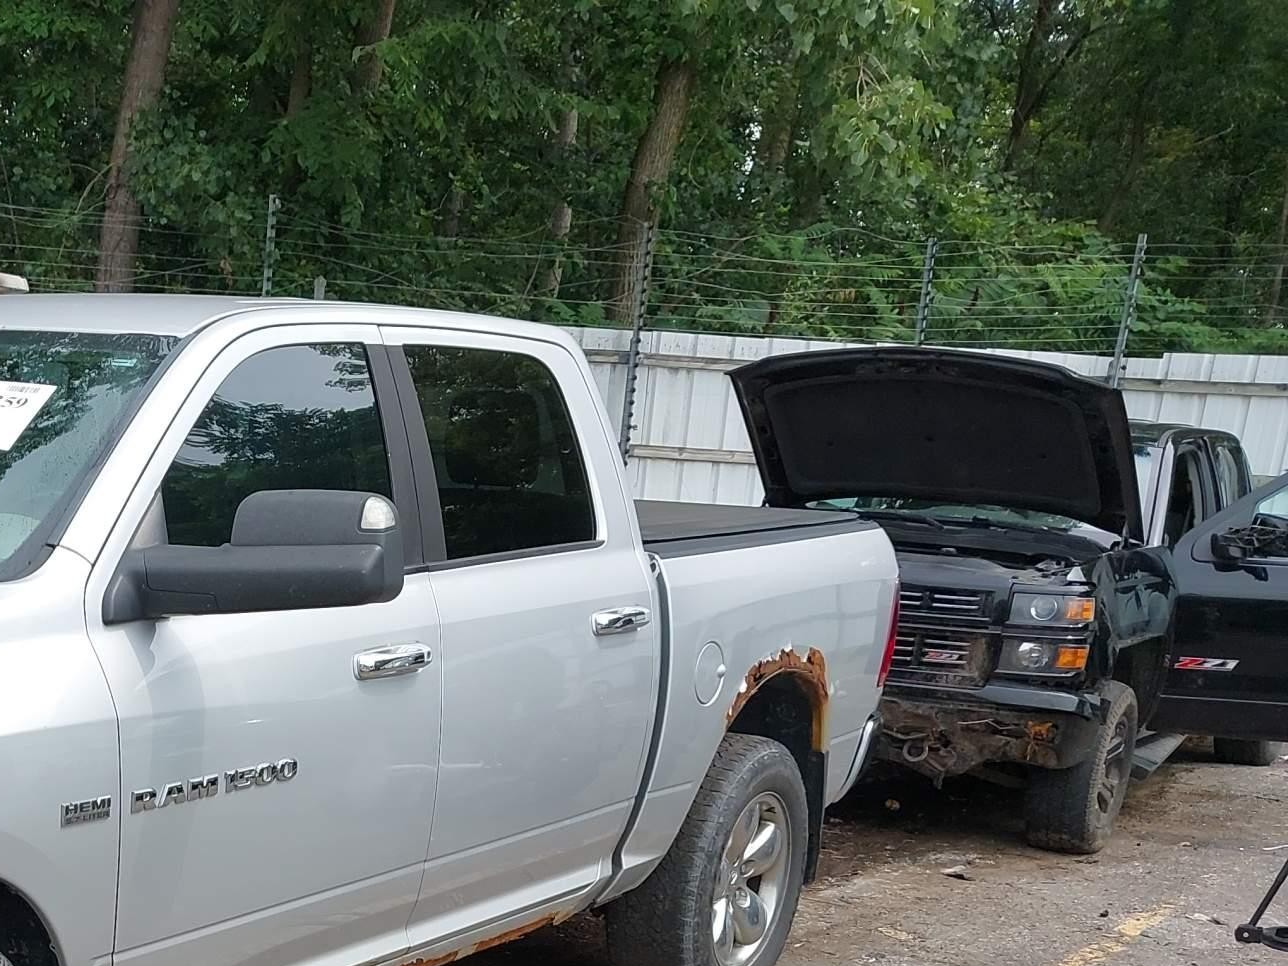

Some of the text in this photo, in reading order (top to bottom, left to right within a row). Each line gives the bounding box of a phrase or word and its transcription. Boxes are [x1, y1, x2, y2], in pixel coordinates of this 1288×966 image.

[1174, 656, 1240, 671] Z71
[130, 758, 298, 815] RAM 1500
[64, 796, 112, 817] HEMI
